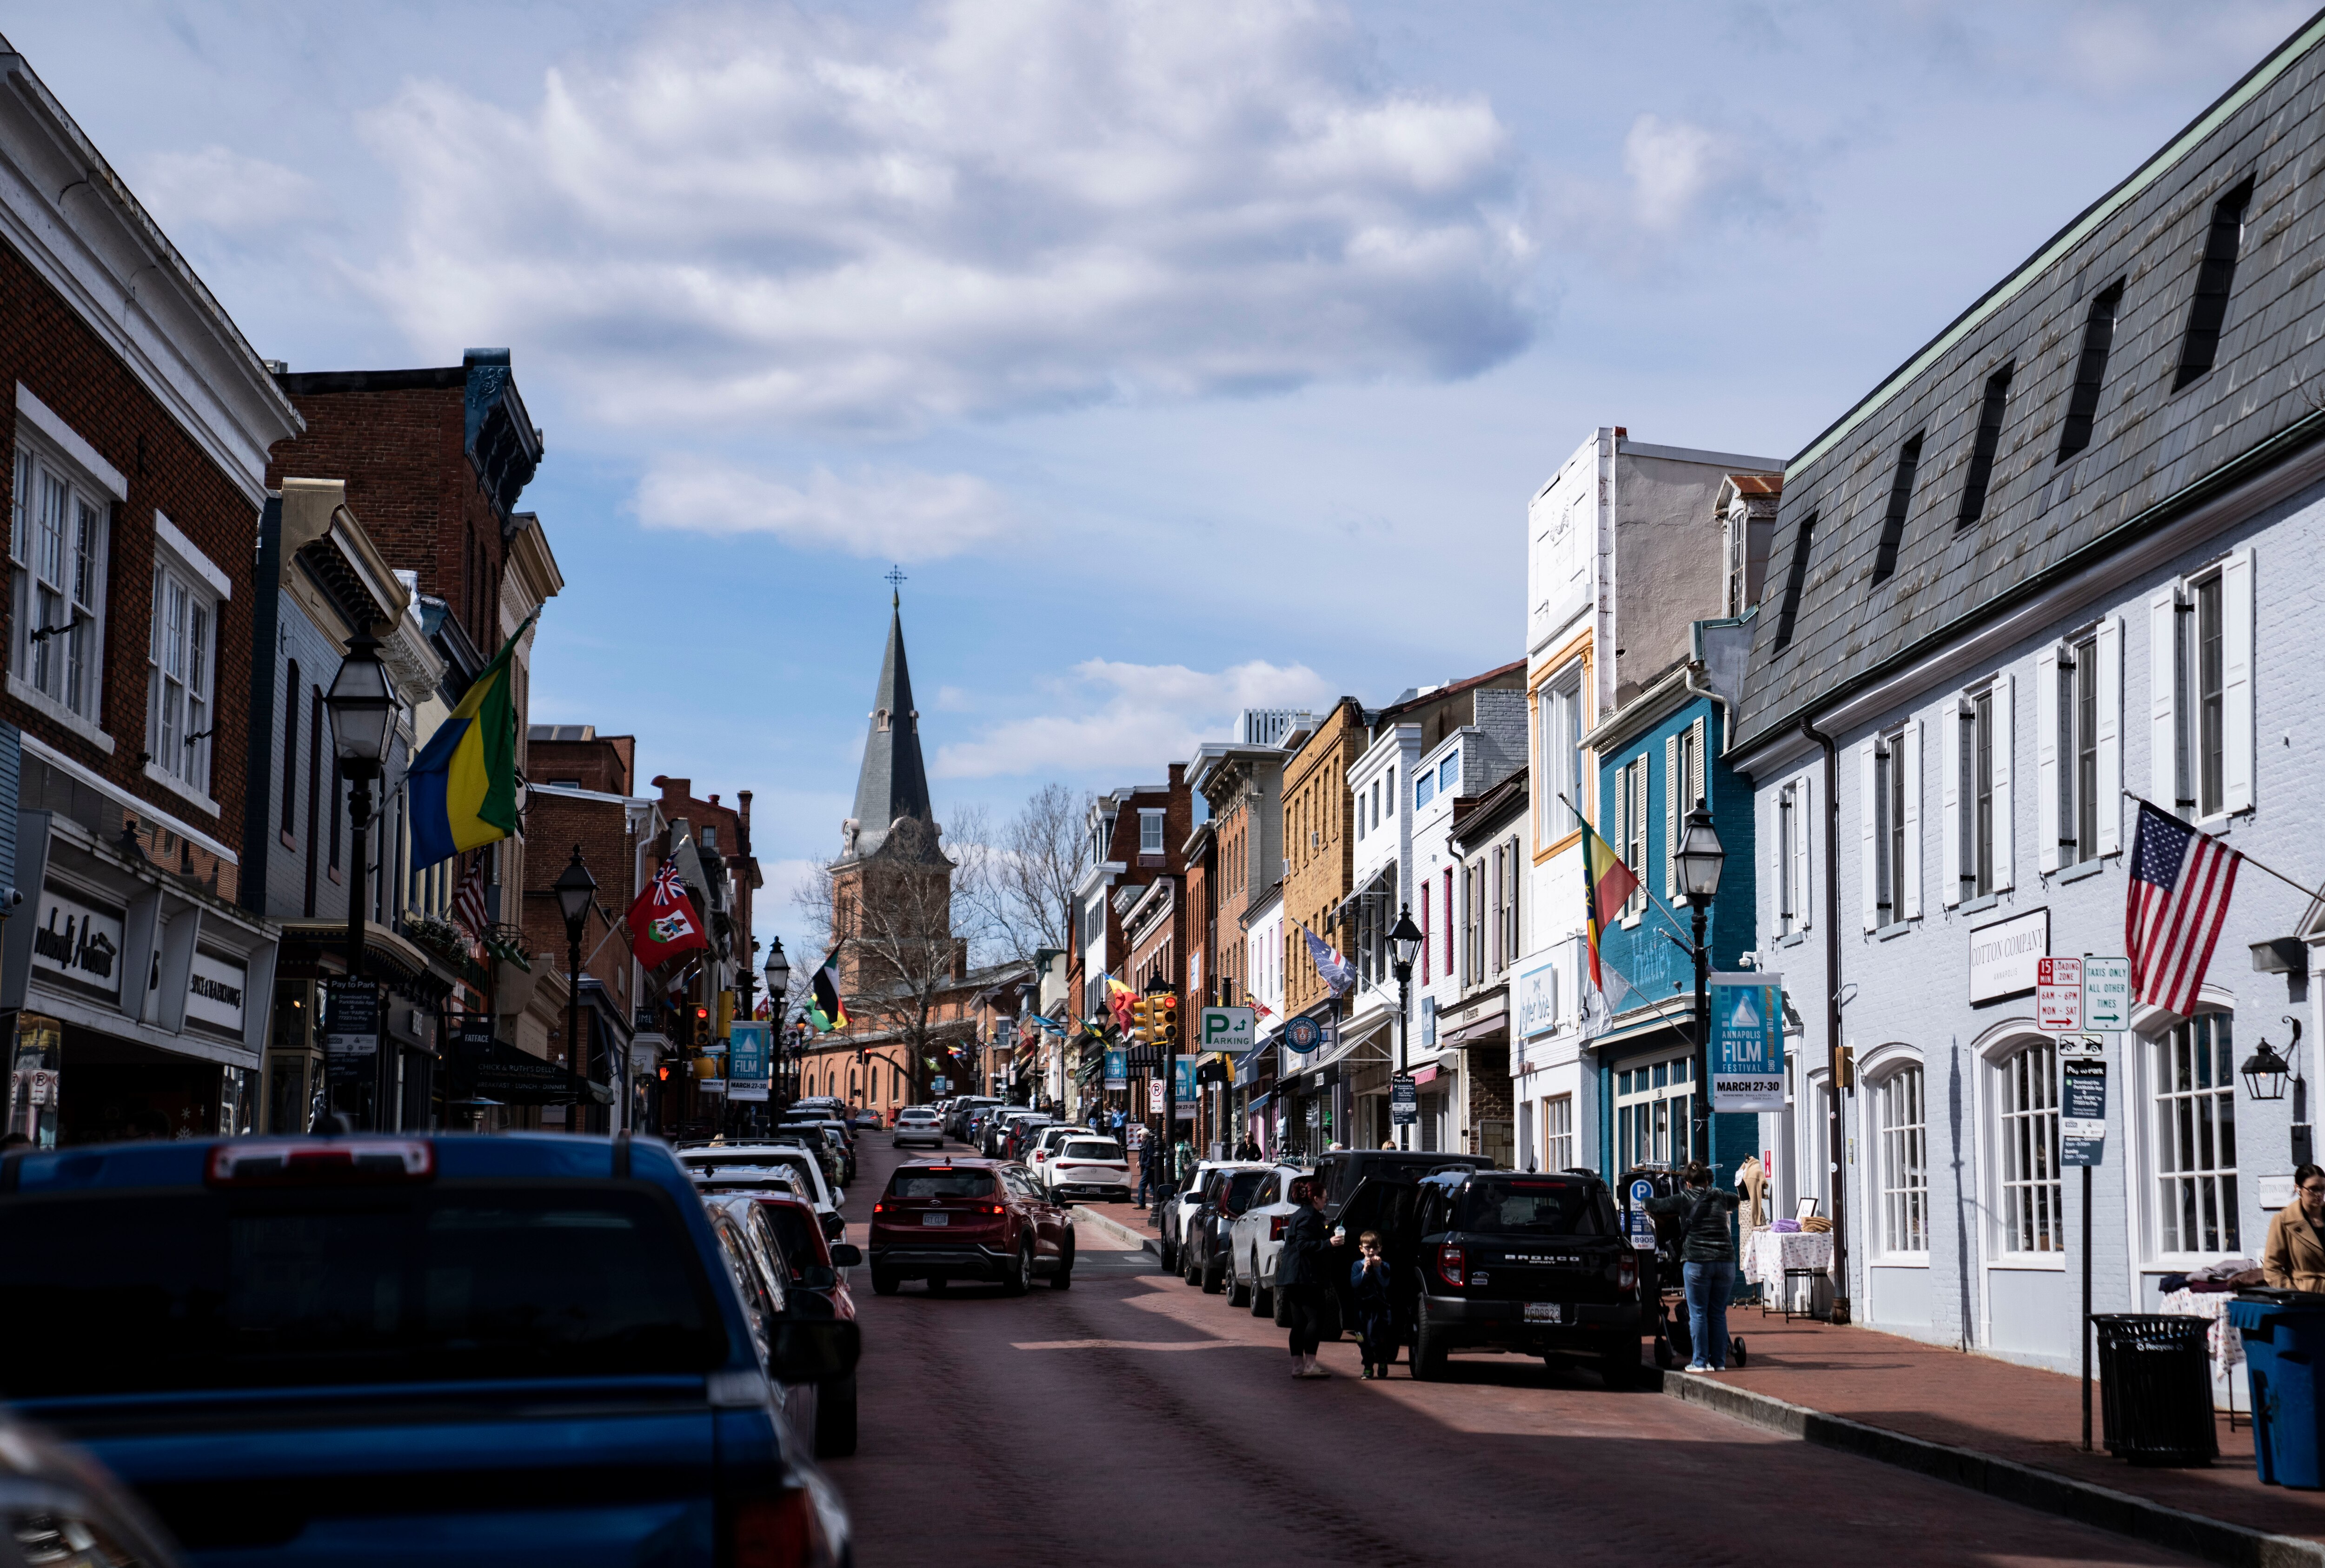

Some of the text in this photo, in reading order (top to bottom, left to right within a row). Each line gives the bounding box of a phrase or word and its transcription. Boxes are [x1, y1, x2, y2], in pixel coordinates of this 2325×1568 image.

[1972, 928, 2044, 967] COTTON COMPANY
[1631, 925, 1671, 990] Hatley
[2041, 960, 2051, 974] 15
[1994, 967, 2018, 981] ANNAPOLIS
[2059, 973, 2074, 981] ZONE
[2087, 968, 2127, 977] TAXIS ONLY
[2039, 975, 2052, 984] MIN
[2088, 984, 2126, 993] ALL OTHER
[2042, 992, 2055, 1000] 6AM
[2064, 992, 2077, 1000] 6PM
[2097, 999, 2117, 1008] TIMES
[2042, 1006, 2056, 1015] MON
[2066, 1006, 2077, 1015] SAT
[1206, 1014, 1249, 1045] PARKING
[1305, 1021, 1316, 1039] BOUTIQUE
[465, 1034, 489, 1043] FATFACE
[1722, 1041, 1762, 1062] FILM
[735, 1060, 757, 1072] FILM
[2066, 1065, 2079, 1075] Pay
[1717, 1081, 1780, 1091] MARCH 27-30
[2145, 1343, 2175, 1352] Recycle
